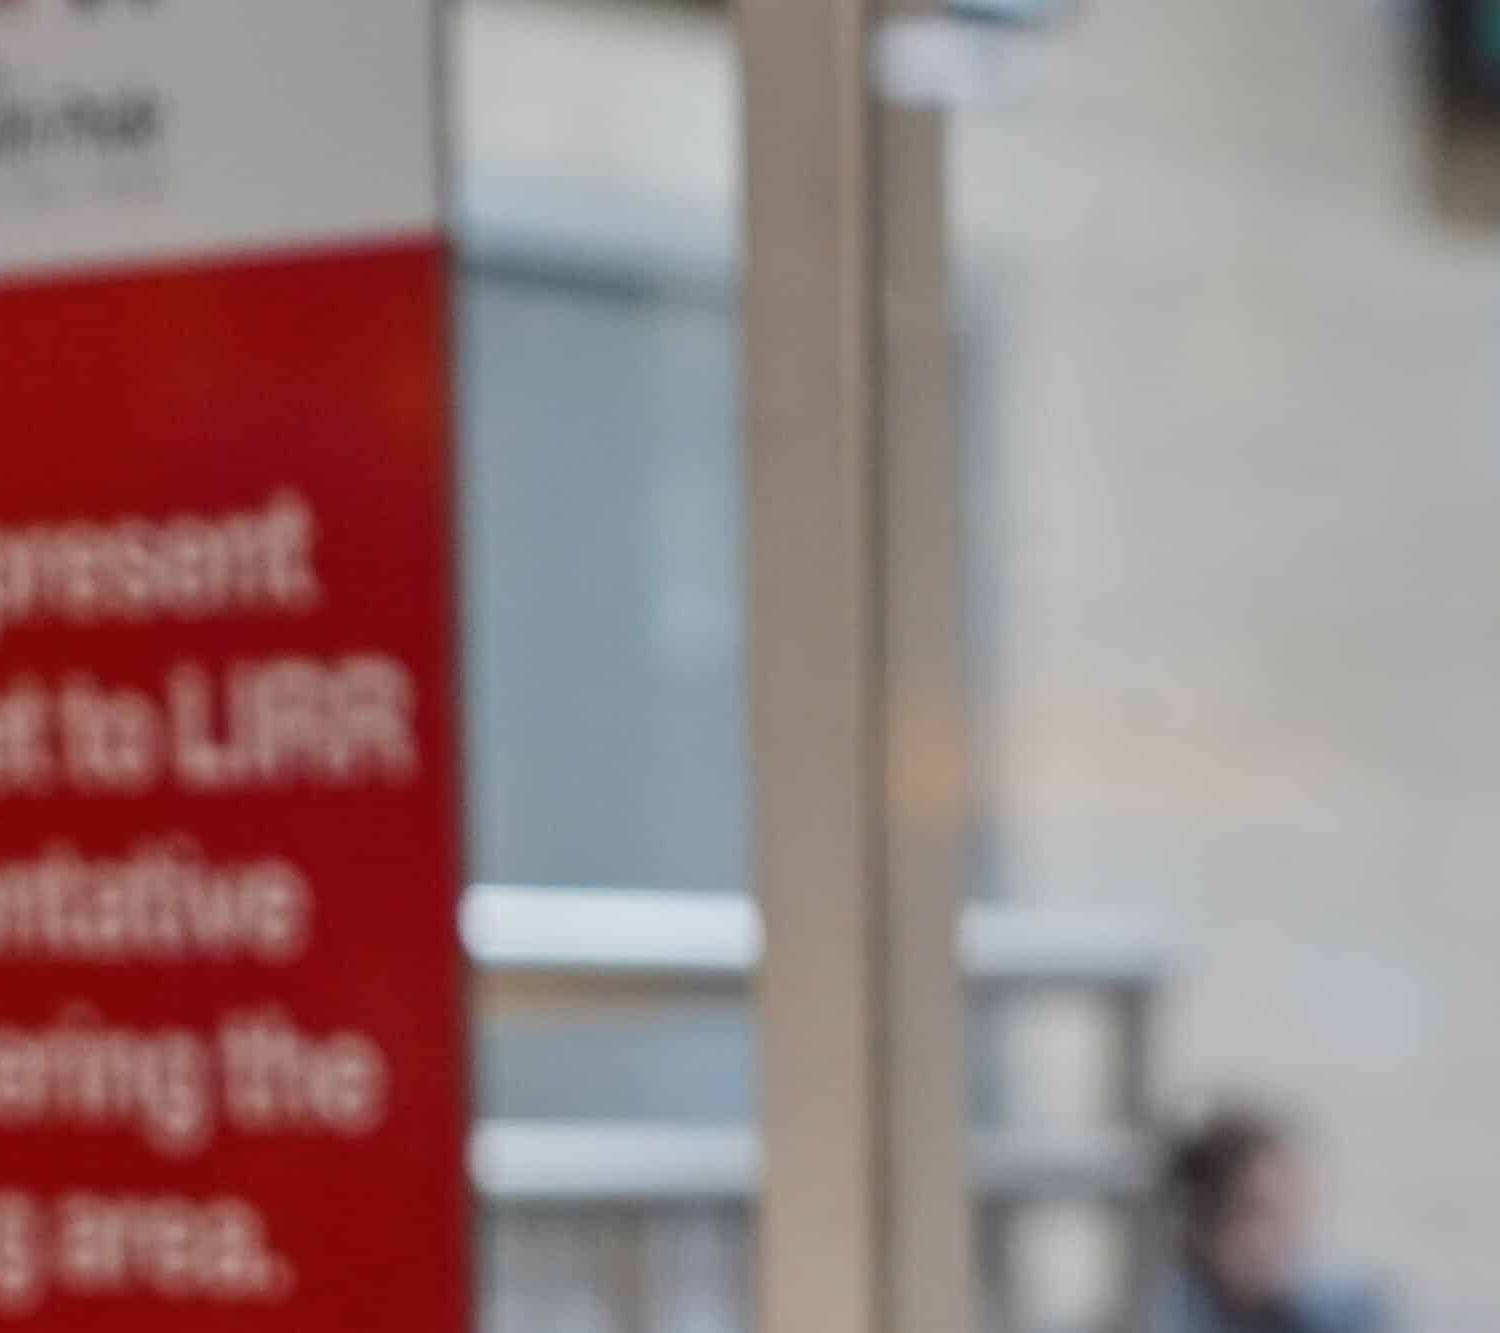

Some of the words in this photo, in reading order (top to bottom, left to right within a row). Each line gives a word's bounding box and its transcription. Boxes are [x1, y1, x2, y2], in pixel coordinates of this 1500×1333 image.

[63, 682, 155, 786] to
[170, 660, 412, 783] LIRR
[220, 1012, 386, 1130] the
[60, 1198, 292, 1300] area.
